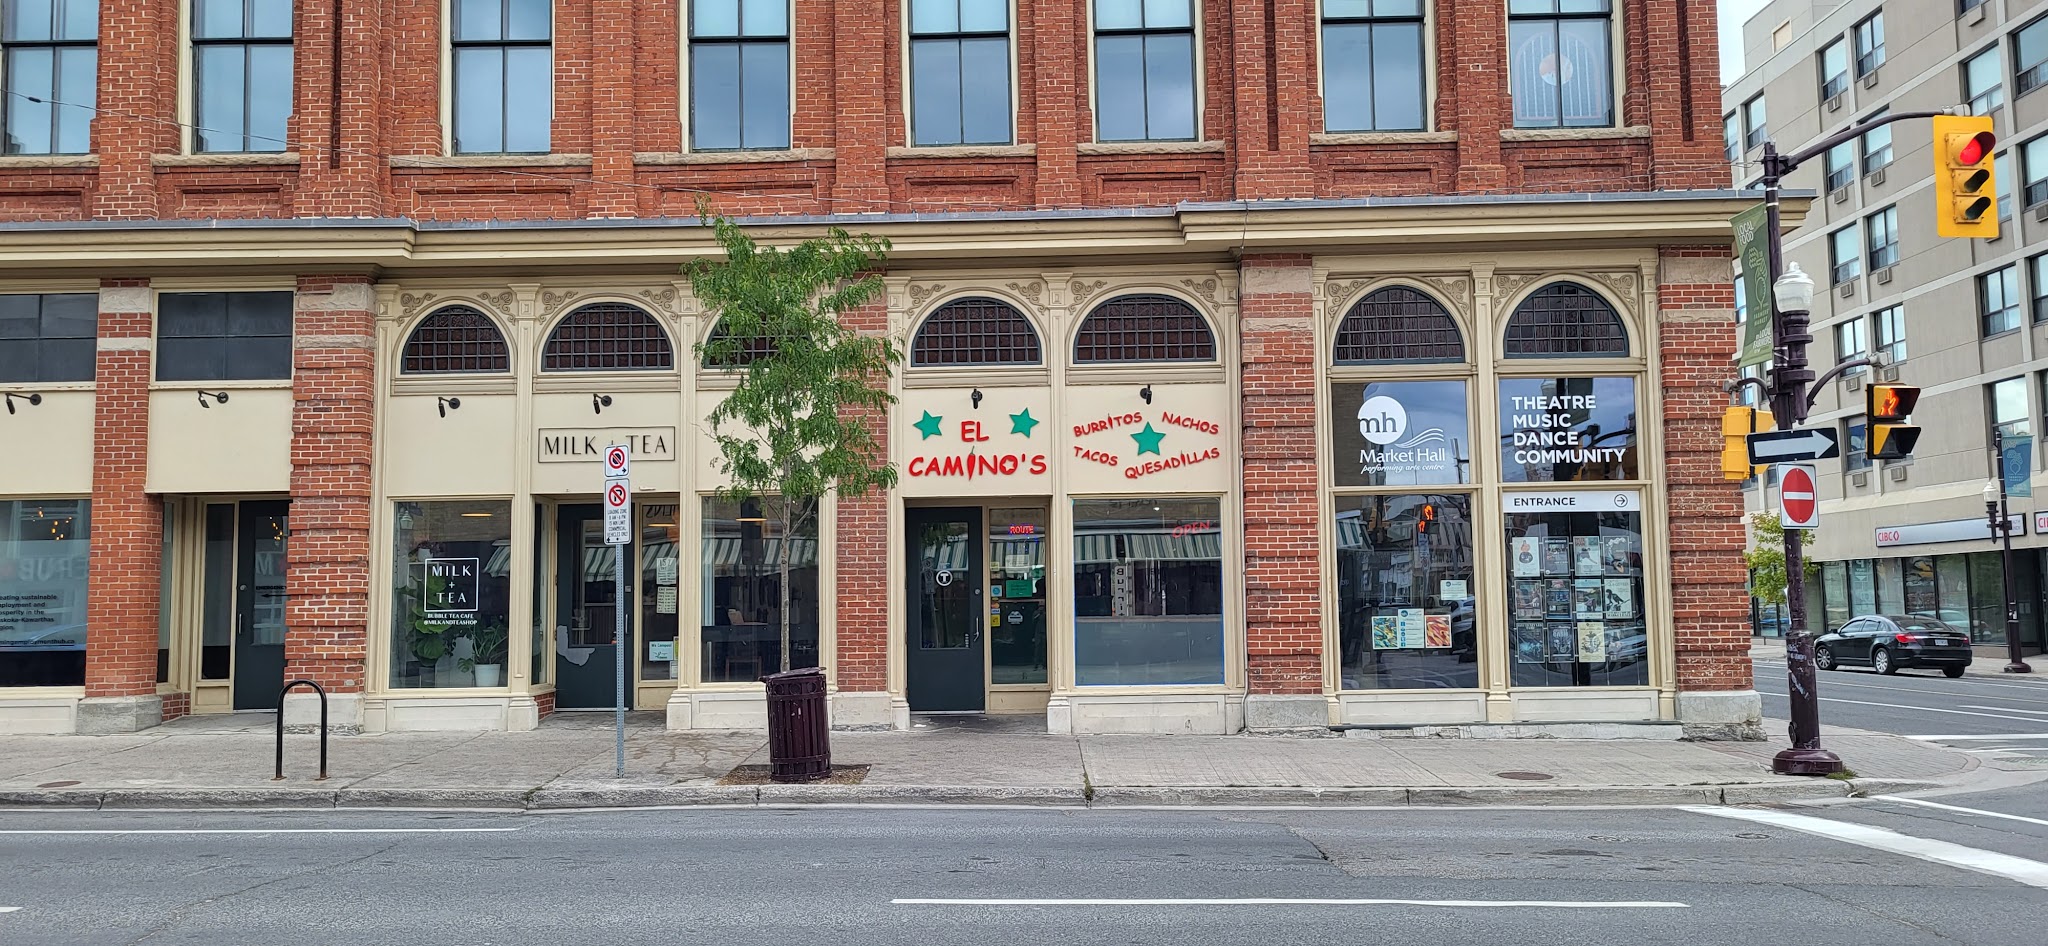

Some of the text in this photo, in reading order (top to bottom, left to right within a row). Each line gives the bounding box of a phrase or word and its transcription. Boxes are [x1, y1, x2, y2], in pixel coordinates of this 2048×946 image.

[1736, 220, 1755, 236] LOCAL
[1739, 231, 1755, 245] FOOD
[1511, 395, 1597, 410] THEATRE
[1073, 412, 1143, 437] BURRITOS
[1161, 411, 1219, 435] NACHOS
[1359, 411, 1398, 433] mh
[1512, 413, 1572, 428] MUSIC
[961, 420, 990, 442] EL
[1513, 431, 1579, 446] DANCE
[544, 434, 667, 455] MILK TEA
[1073, 446, 1119, 467] TACOS
[1124, 447, 1220, 479] QUESADILLAS
[1359, 448, 1446, 463] Market Hall
[1514, 448, 1627, 464] COMMUNITY
[908, 450, 1047, 481] CAMINO'S
[1360, 464, 1403, 474] performing
[1514, 497, 1576, 506] ENTRANCE
[1010, 525, 1034, 534] ROUTE
[1172, 520, 1211, 538] OPEN
[1877, 531, 1893, 542] CIBC
[432, 565, 472, 577] MILK
[436, 592, 467, 604] TEA
